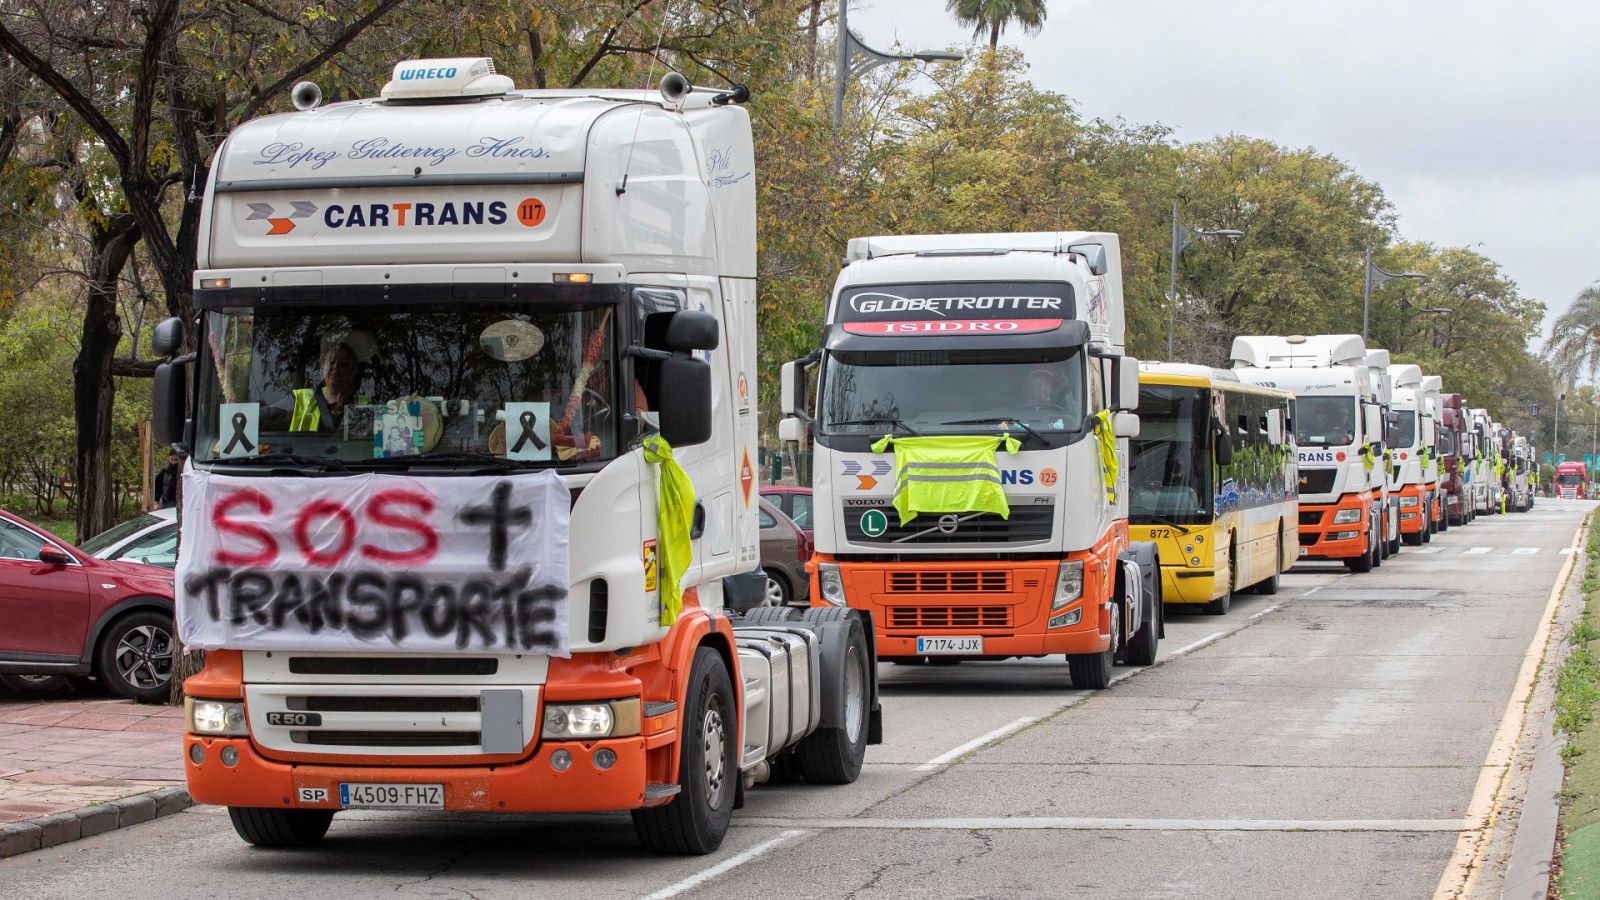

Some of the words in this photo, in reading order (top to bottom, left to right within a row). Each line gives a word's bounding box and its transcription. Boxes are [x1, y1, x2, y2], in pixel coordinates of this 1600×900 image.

[400, 67, 457, 80] WAECO
[347, 137, 460, 167] Gutierrez
[324, 201, 508, 229] CARTRANS
[520, 204, 543, 220] 117
[850, 292, 1062, 317] GLOBETROTTER
[884, 320, 1018, 333] ISIDRO
[1040, 472, 1057, 483] 125
[211, 487, 440, 568] SOS
[1150, 529, 1170, 539] 872
[184, 562, 569, 650] TRANSPORTE
[926, 639, 953, 650] 7174
[957, 639, 979, 650] JJX
[302, 789, 326, 801] SP
[353, 786, 399, 805] 4509
[404, 787, 440, 804] FHZ
